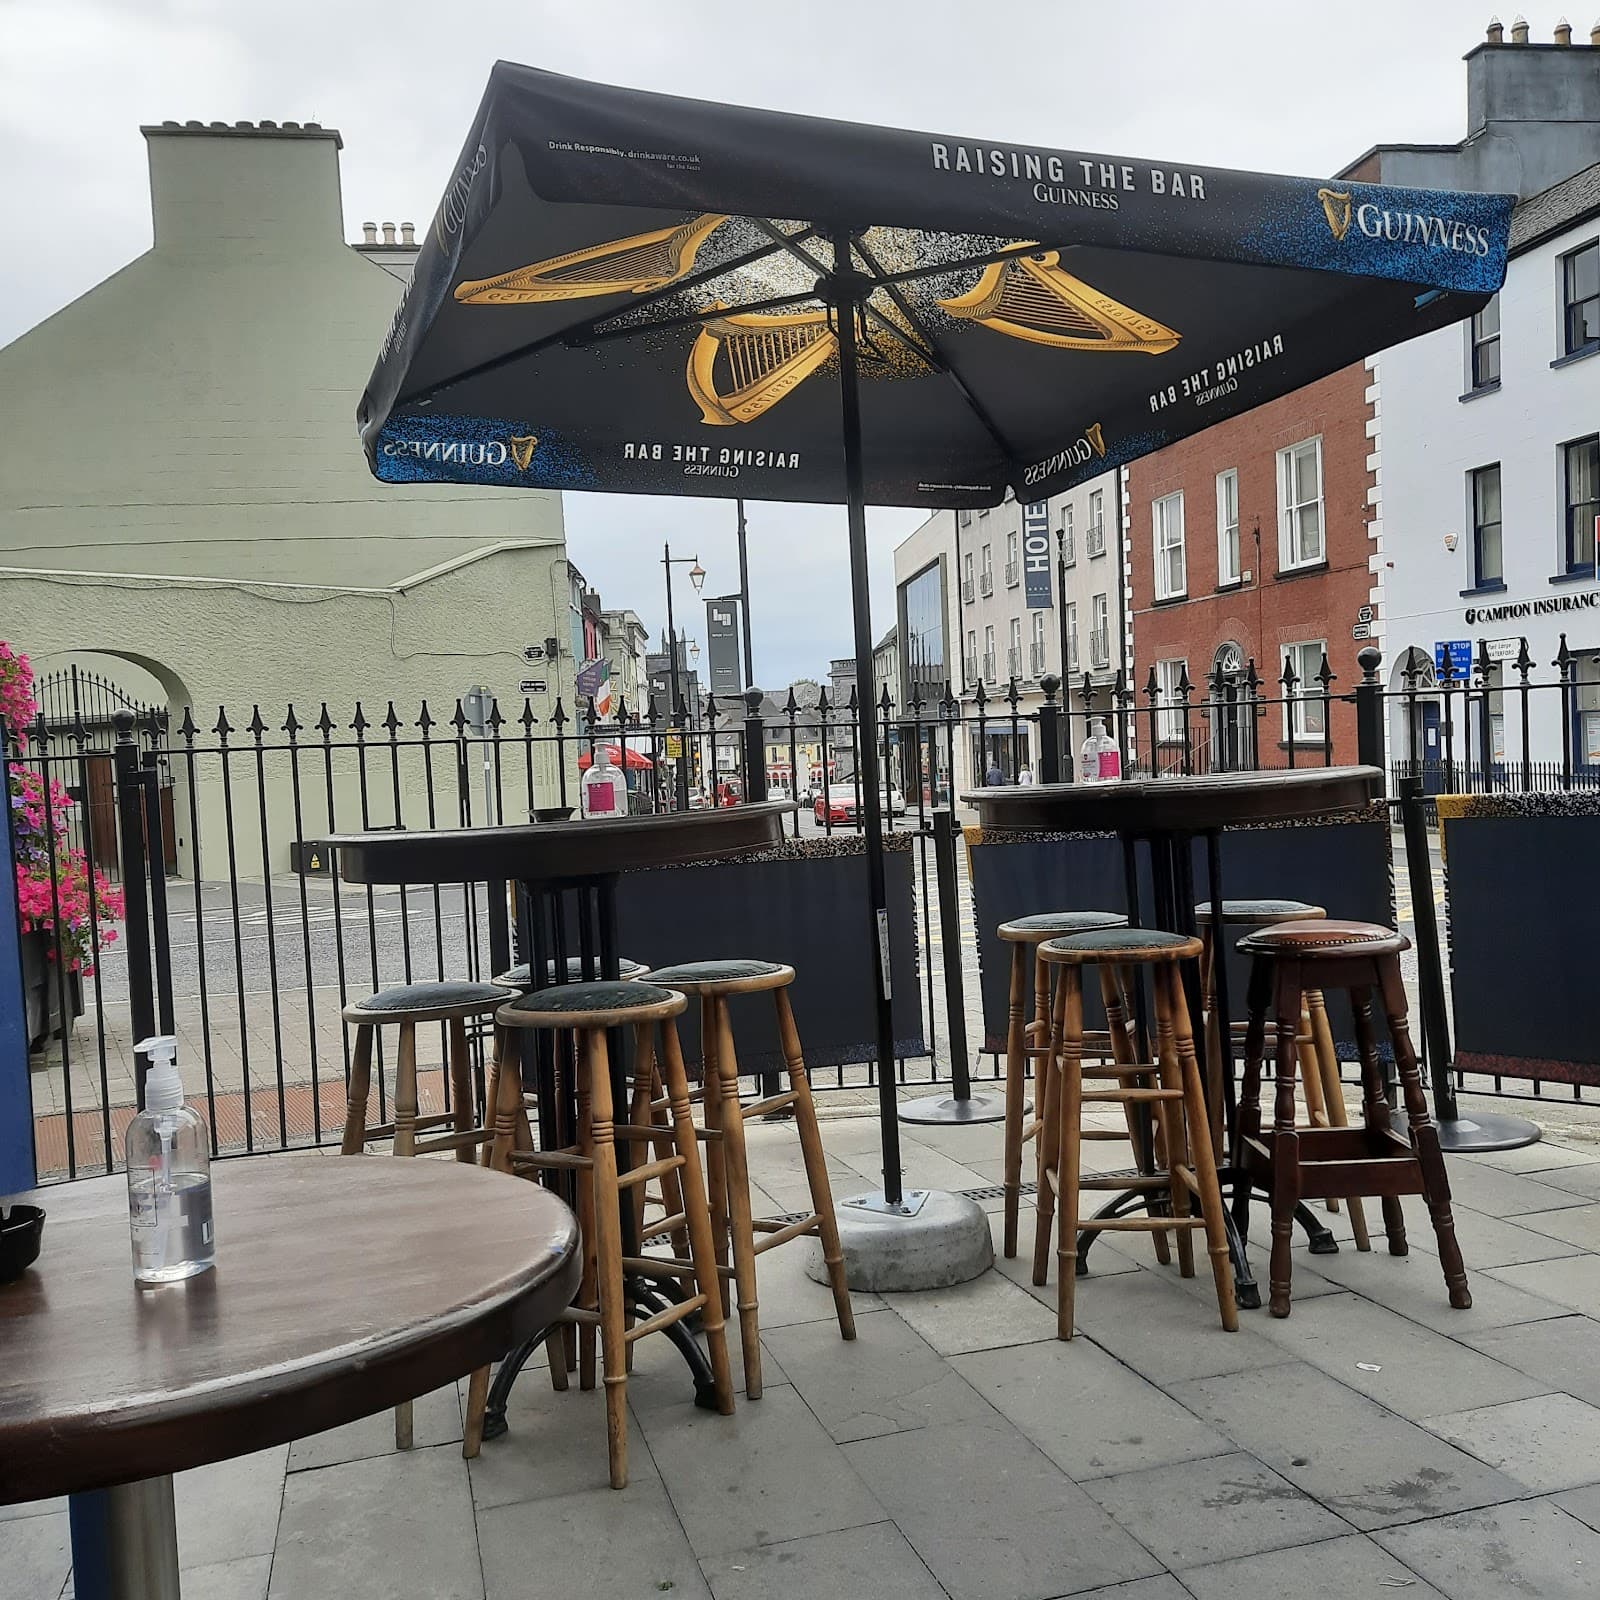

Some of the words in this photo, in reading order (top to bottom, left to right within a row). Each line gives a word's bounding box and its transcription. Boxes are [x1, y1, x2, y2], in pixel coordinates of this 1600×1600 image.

[548, 140, 573, 151] Drink
[574, 143, 628, 157] Responsibly.
[627, 149, 701, 163] drinkaware.co.uk
[932, 143, 1064, 183] RAISING
[1079, 160, 1136, 191] THE
[1151, 169, 1206, 200] BAR
[1033, 183, 1119, 210] GUINNESS
[1357, 203, 1490, 257] GUINNESS
[1024, 500, 1049, 572] HOTE
[1477, 602, 1531, 623] CAMPION
[1533, 591, 1600, 615] INSURANC
[1452, 642, 1470, 650] STOP
